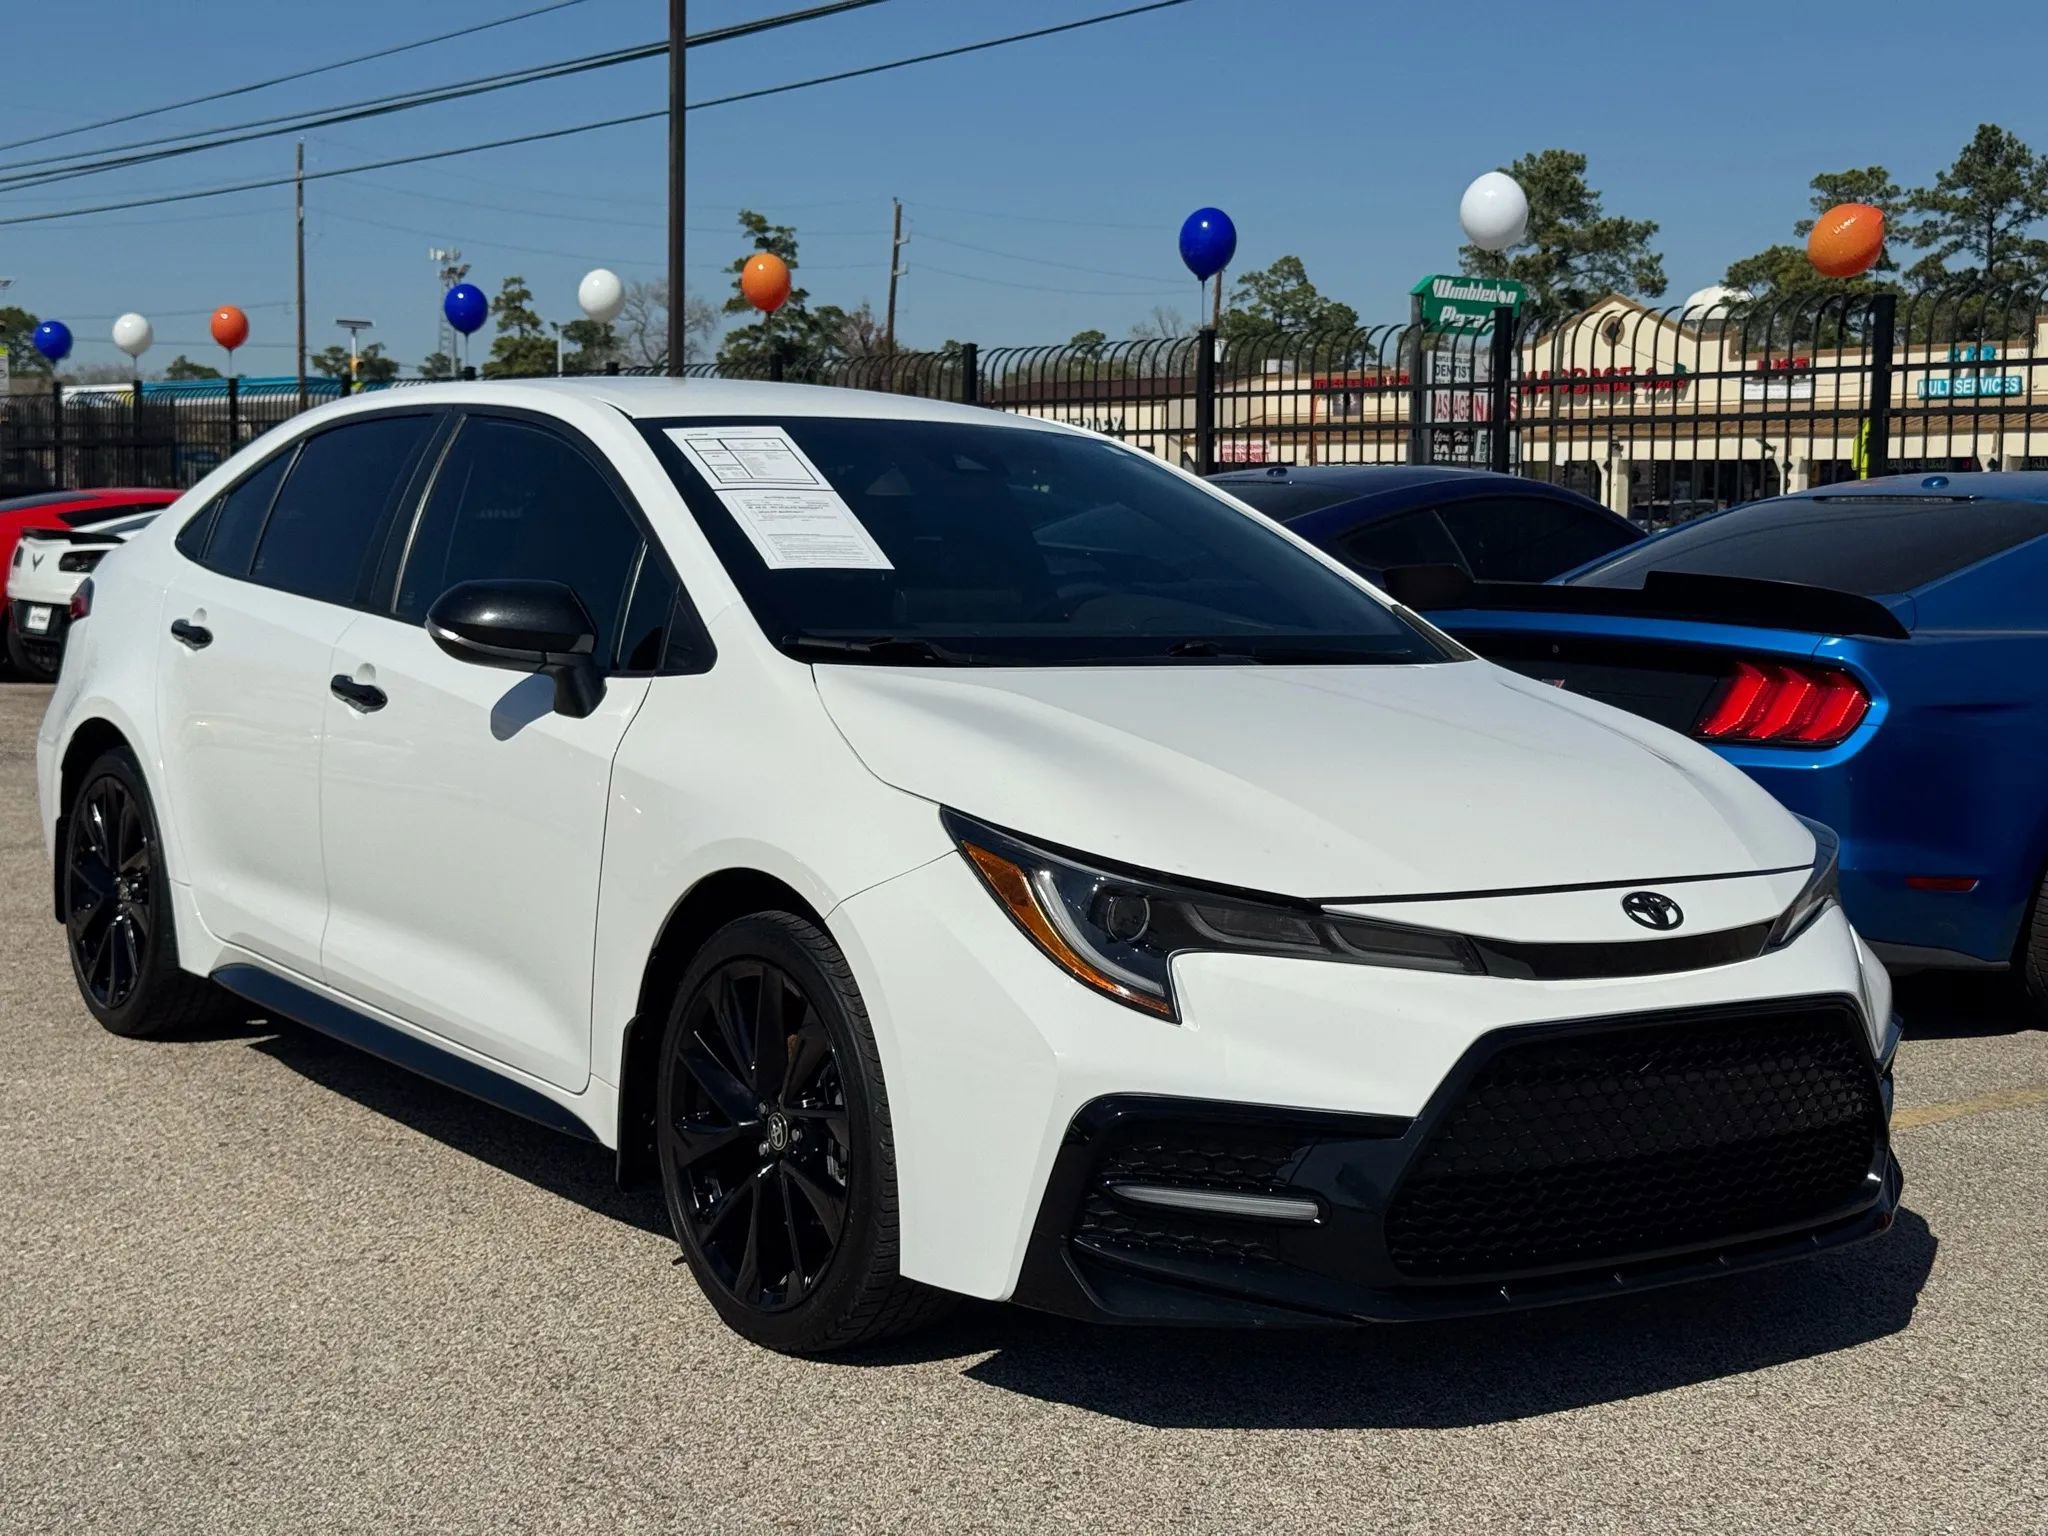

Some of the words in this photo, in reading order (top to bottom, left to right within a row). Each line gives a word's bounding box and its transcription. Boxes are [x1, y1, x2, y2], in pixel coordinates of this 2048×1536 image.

[1432, 279, 1518, 304] Wimbledon
[1440, 305, 1487, 329] Plaza
[1918, 379, 1951, 396] MULT
[1431, 393, 1470, 419] ASAGE
